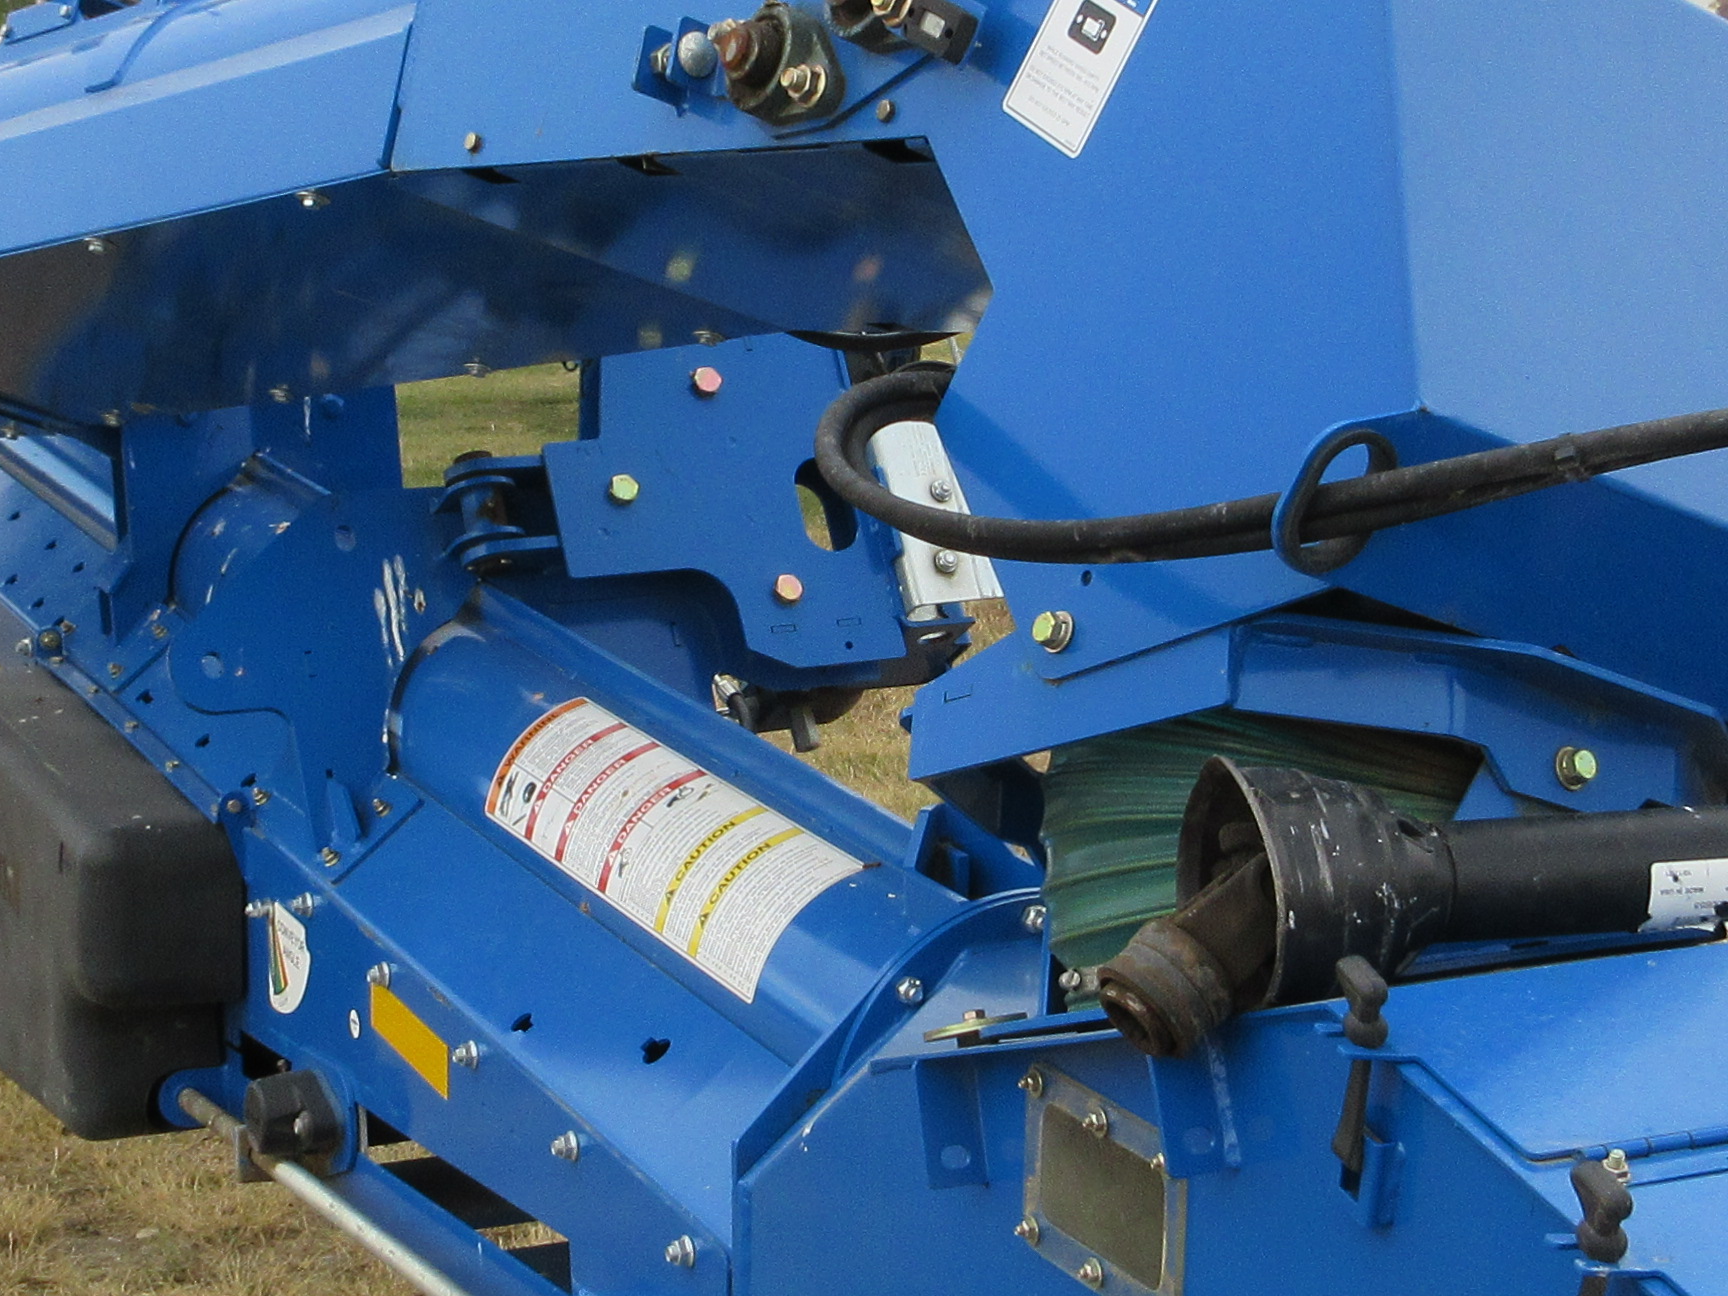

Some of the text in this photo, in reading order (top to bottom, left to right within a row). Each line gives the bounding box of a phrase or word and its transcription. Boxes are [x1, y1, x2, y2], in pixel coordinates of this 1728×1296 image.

[542, 738, 593, 793] DANGER
[573, 759, 626, 814] DANGER
[617, 786, 672, 844] DANGER
[675, 820, 736, 882] CAUTION
[709, 842, 772, 905] CAUTION
